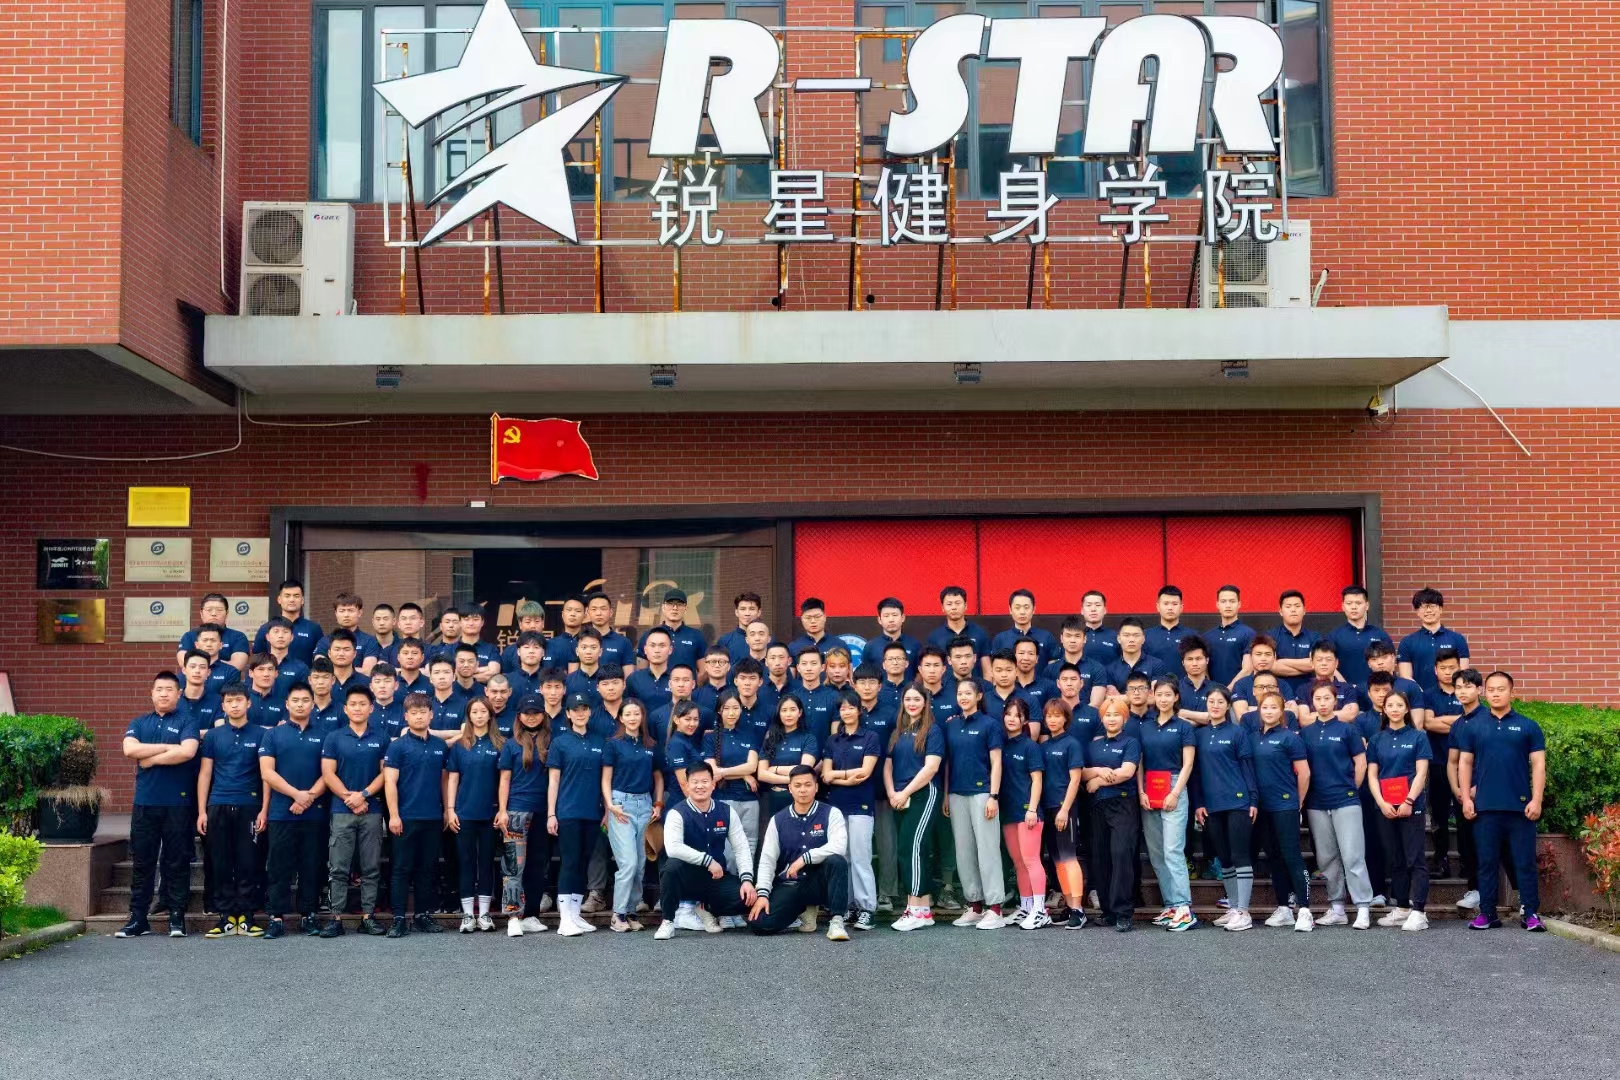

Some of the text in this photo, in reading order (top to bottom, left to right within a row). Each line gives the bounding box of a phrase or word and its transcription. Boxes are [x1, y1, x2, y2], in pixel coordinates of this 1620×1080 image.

[648, 14, 1284, 157] R-STAR
[649, 163, 1280, 248] 锐星健身学院
